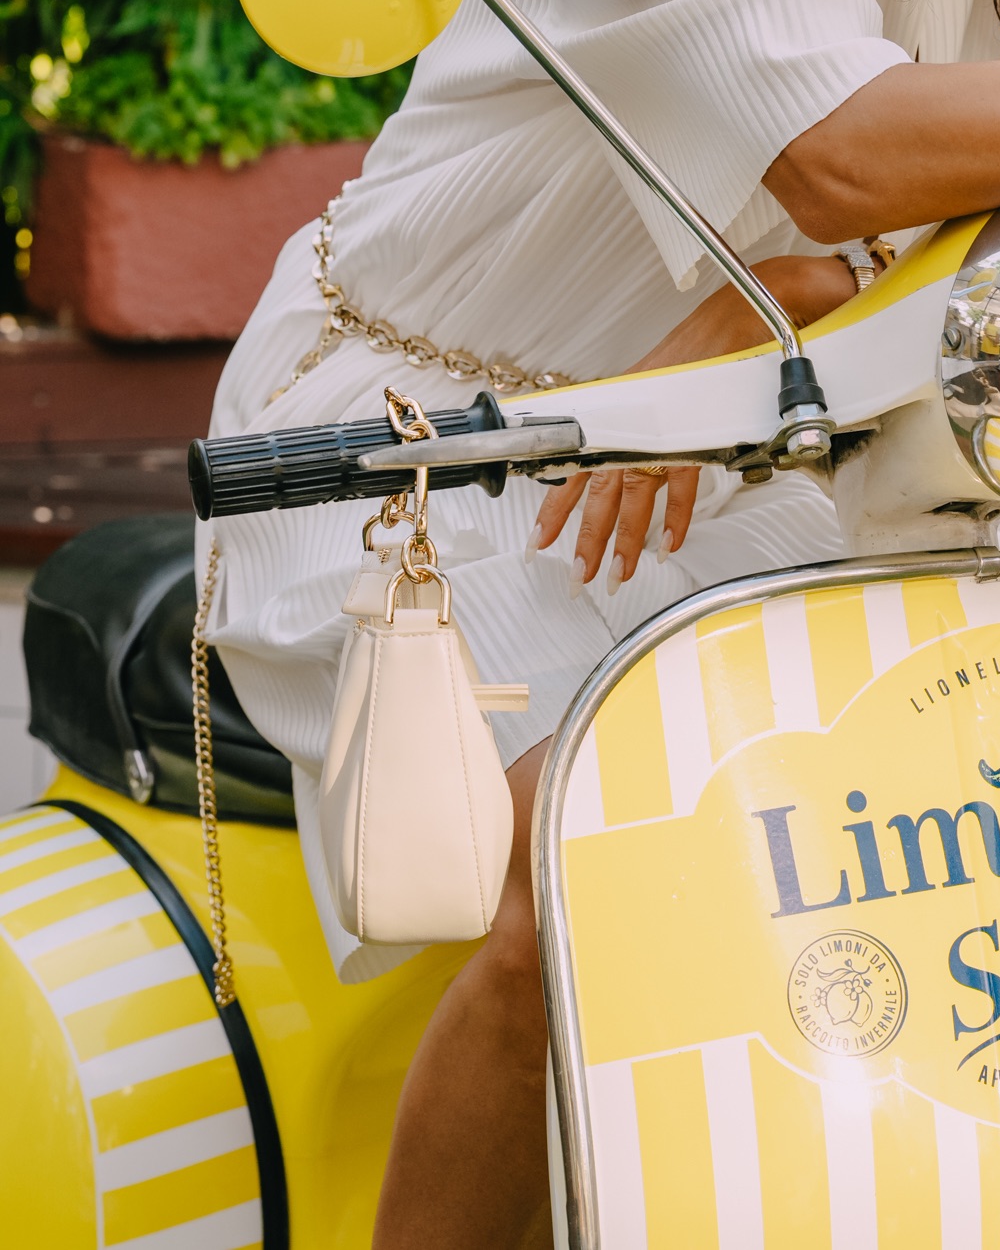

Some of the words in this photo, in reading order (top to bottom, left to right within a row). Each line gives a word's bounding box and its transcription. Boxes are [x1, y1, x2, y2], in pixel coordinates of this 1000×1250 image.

[794, 953, 819, 988] SOLO
[819, 939, 869, 958] LIMONI
[869, 953, 887, 973] DA
[796, 1005, 850, 1051] RACCOLTO
[854, 990, 898, 1050] INVERNALE
